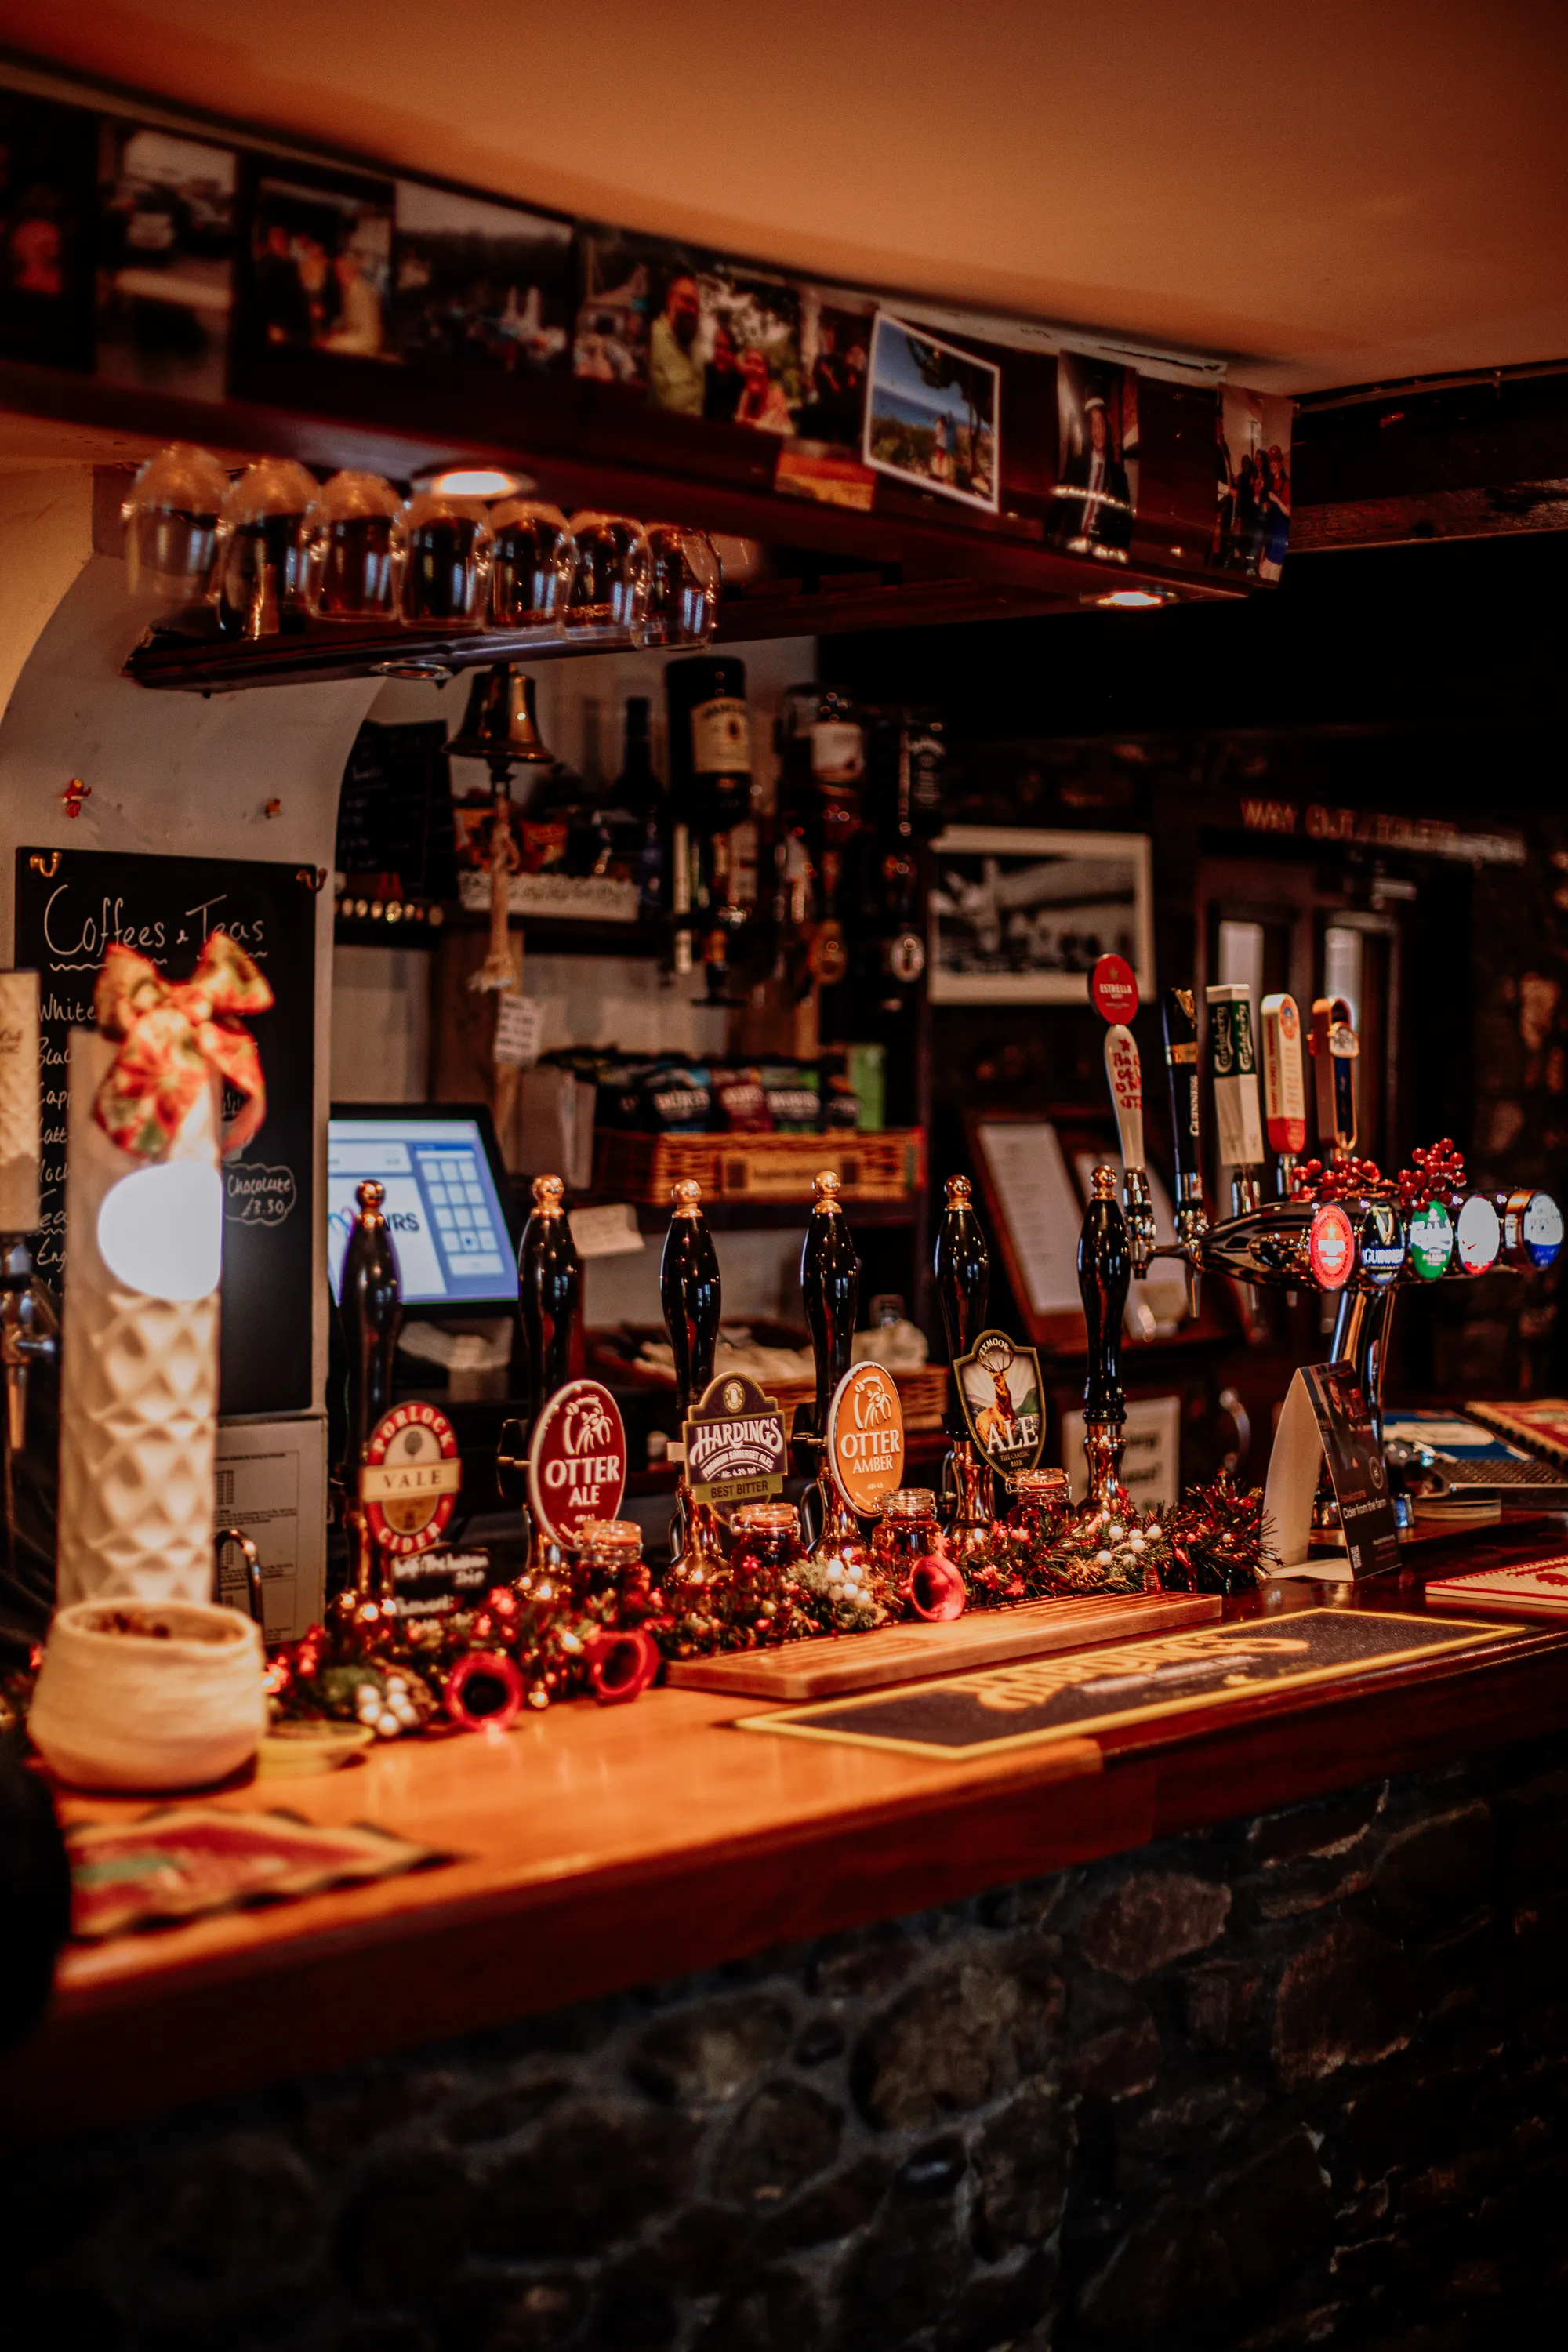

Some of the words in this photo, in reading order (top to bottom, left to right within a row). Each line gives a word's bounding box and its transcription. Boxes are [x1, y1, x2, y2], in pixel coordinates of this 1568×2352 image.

[1240, 795, 1298, 836] WAY
[1305, 803, 1357, 841] OUT
[44, 884, 166, 956] Coffees
[185, 894, 265, 944] Teas
[37, 993, 98, 1022] White
[1189, 1074, 1200, 1138] GUINNESS
[980, 1338, 1010, 1356] EXMOOR
[373, 1405, 455, 1454] PORLOCK
[689, 1417, 784, 1466] HARDINGS
[840, 1429, 902, 1458] OTTER
[986, 1415, 1040, 1454] ALE
[545, 1455, 621, 1488] OTTER
[728, 1449, 760, 1461] SOMERSET
[759, 1453, 775, 1469] ALES
[852, 1455, 895, 1475] AMBER
[383, 1469, 443, 1489] VALE
[711, 1484, 734, 1499] BEST
[737, 1480, 768, 1495] BITTER
[568, 1485, 601, 1508] ALE
[1342, 1506, 1356, 1519] Cider
[377, 1522, 442, 1553] CIDER
